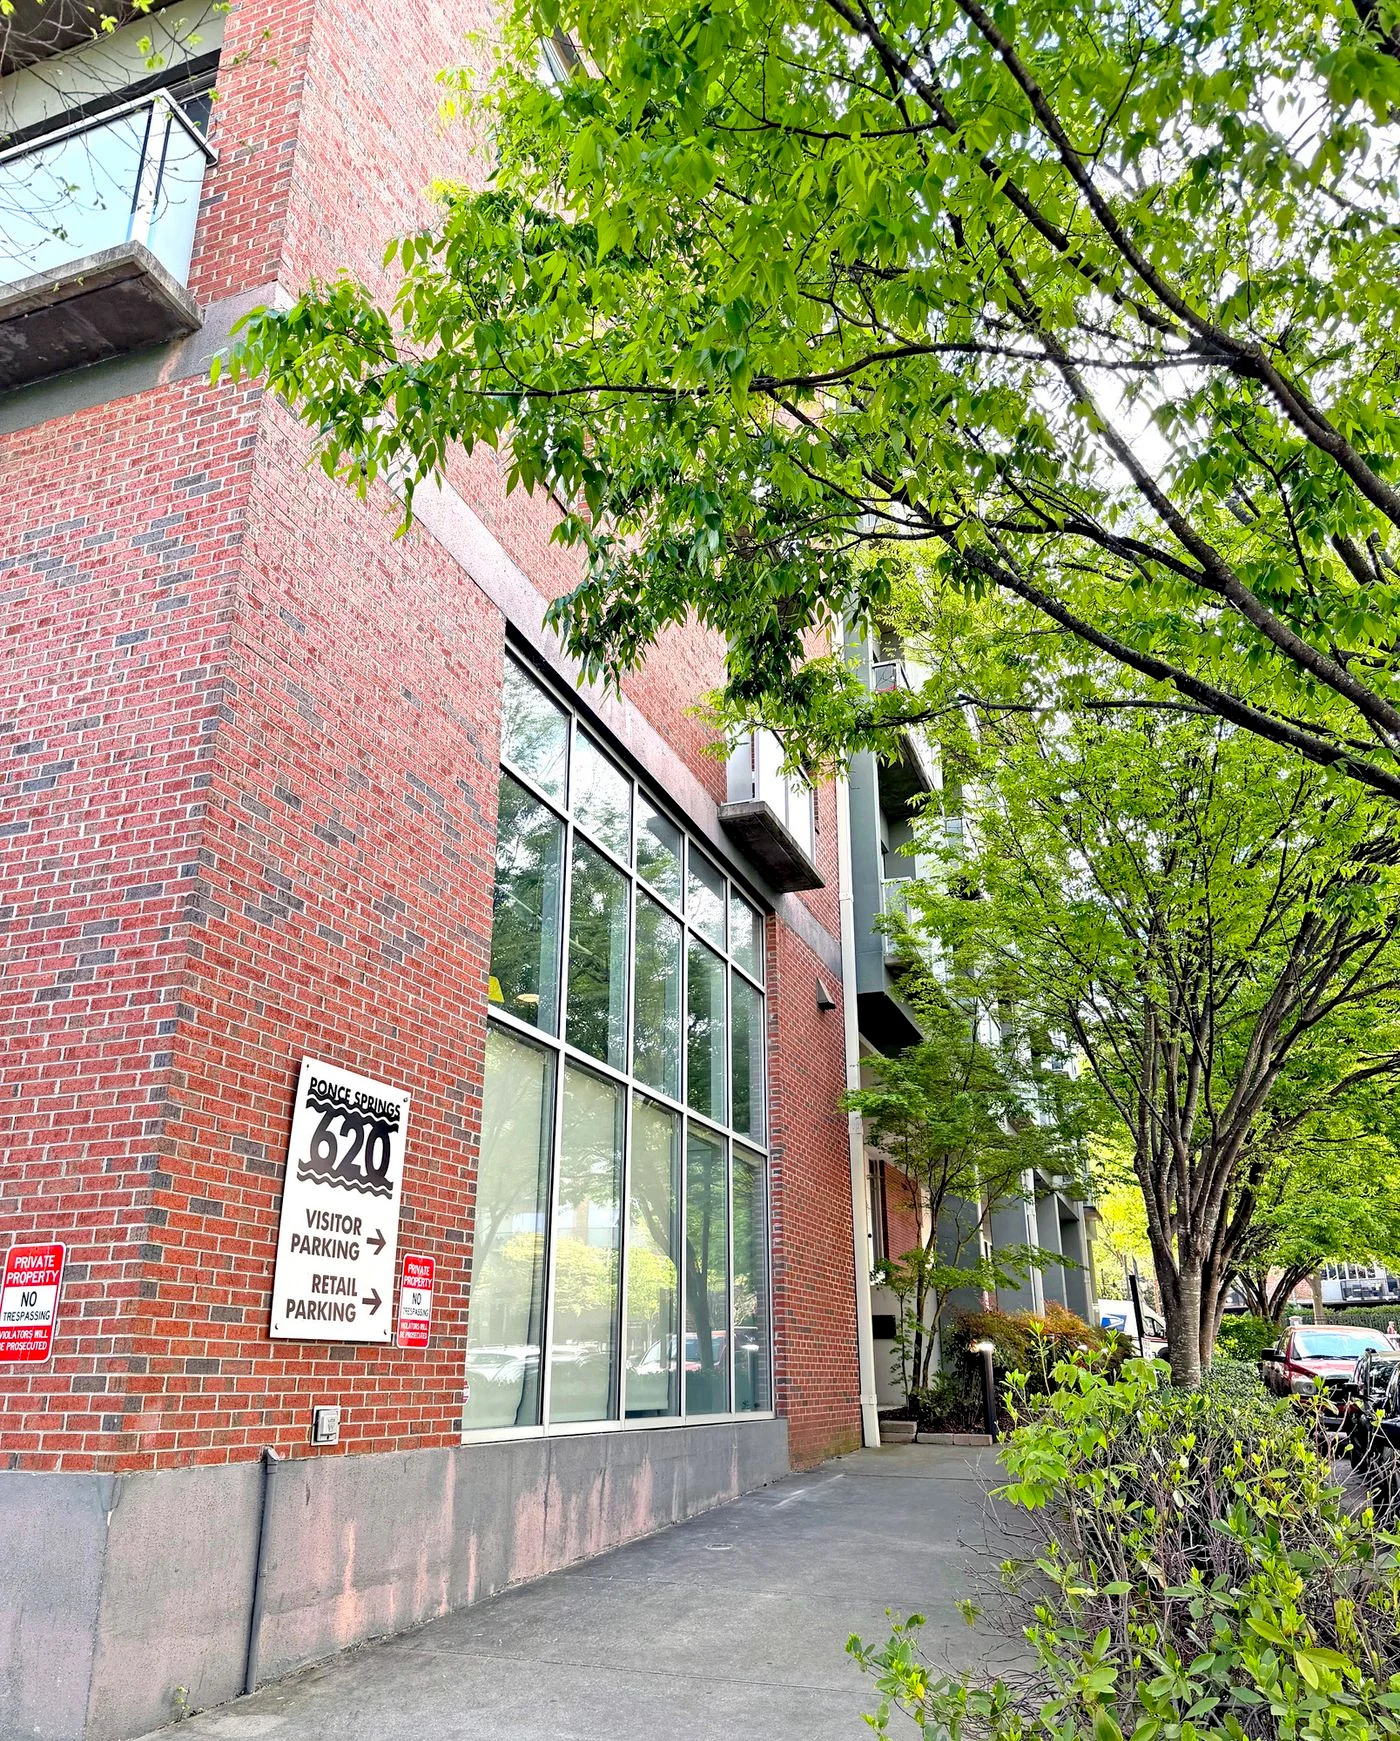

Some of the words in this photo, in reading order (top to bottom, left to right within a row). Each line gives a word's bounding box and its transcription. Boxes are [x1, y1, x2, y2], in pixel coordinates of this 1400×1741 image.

[309, 1077, 351, 1100] PONCE
[354, 1091, 400, 1117] SPRINGS
[310, 1110, 391, 1179] 620
[306, 1208, 362, 1236] VISITOR
[291, 1233, 360, 1261] PARKING
[14, 1255, 56, 1269] PRIVATE
[6, 1270, 59, 1285] PROPERTY
[408, 1264, 430, 1276] PRIVATE
[311, 1273, 358, 1297] RETAIL
[403, 1275, 433, 1288] PROPERTY
[20, 1291, 38, 1307] NO
[412, 1292, 422, 1305] NO
[3, 1310, 51, 1321] TRESPASSING
[286, 1298, 356, 1323] PARKING
[33, 1329, 49, 1339] WILL
[6, 1341, 48, 1351] PROSECUTED
